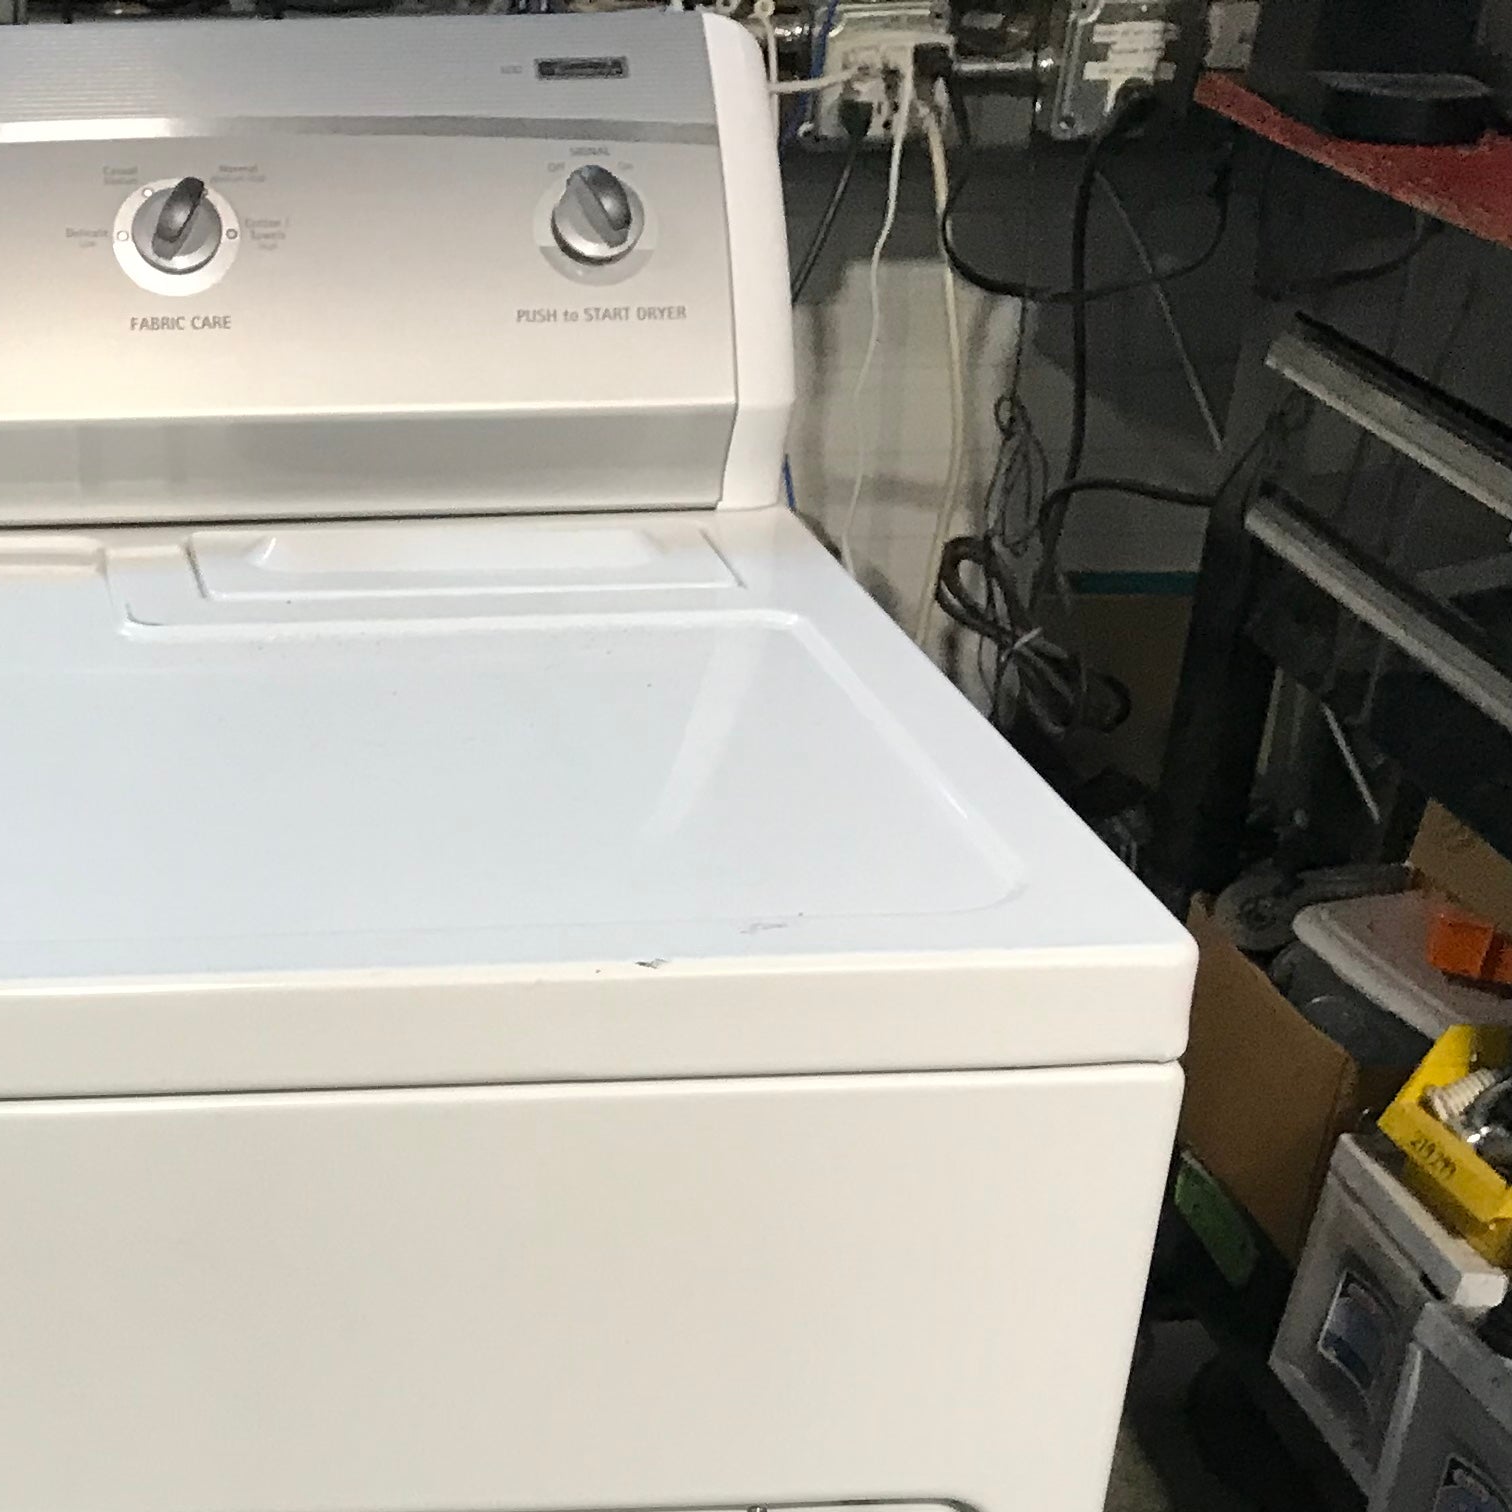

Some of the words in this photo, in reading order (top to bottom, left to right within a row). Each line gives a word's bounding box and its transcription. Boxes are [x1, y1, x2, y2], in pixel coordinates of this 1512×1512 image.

[130, 316, 186, 330] FABRIC
[190, 315, 232, 330] CARE
[516, 308, 557, 323] PUSH
[564, 309, 579, 322] to
[584, 307, 630, 322] START
[637, 306, 687, 321] DRYER
